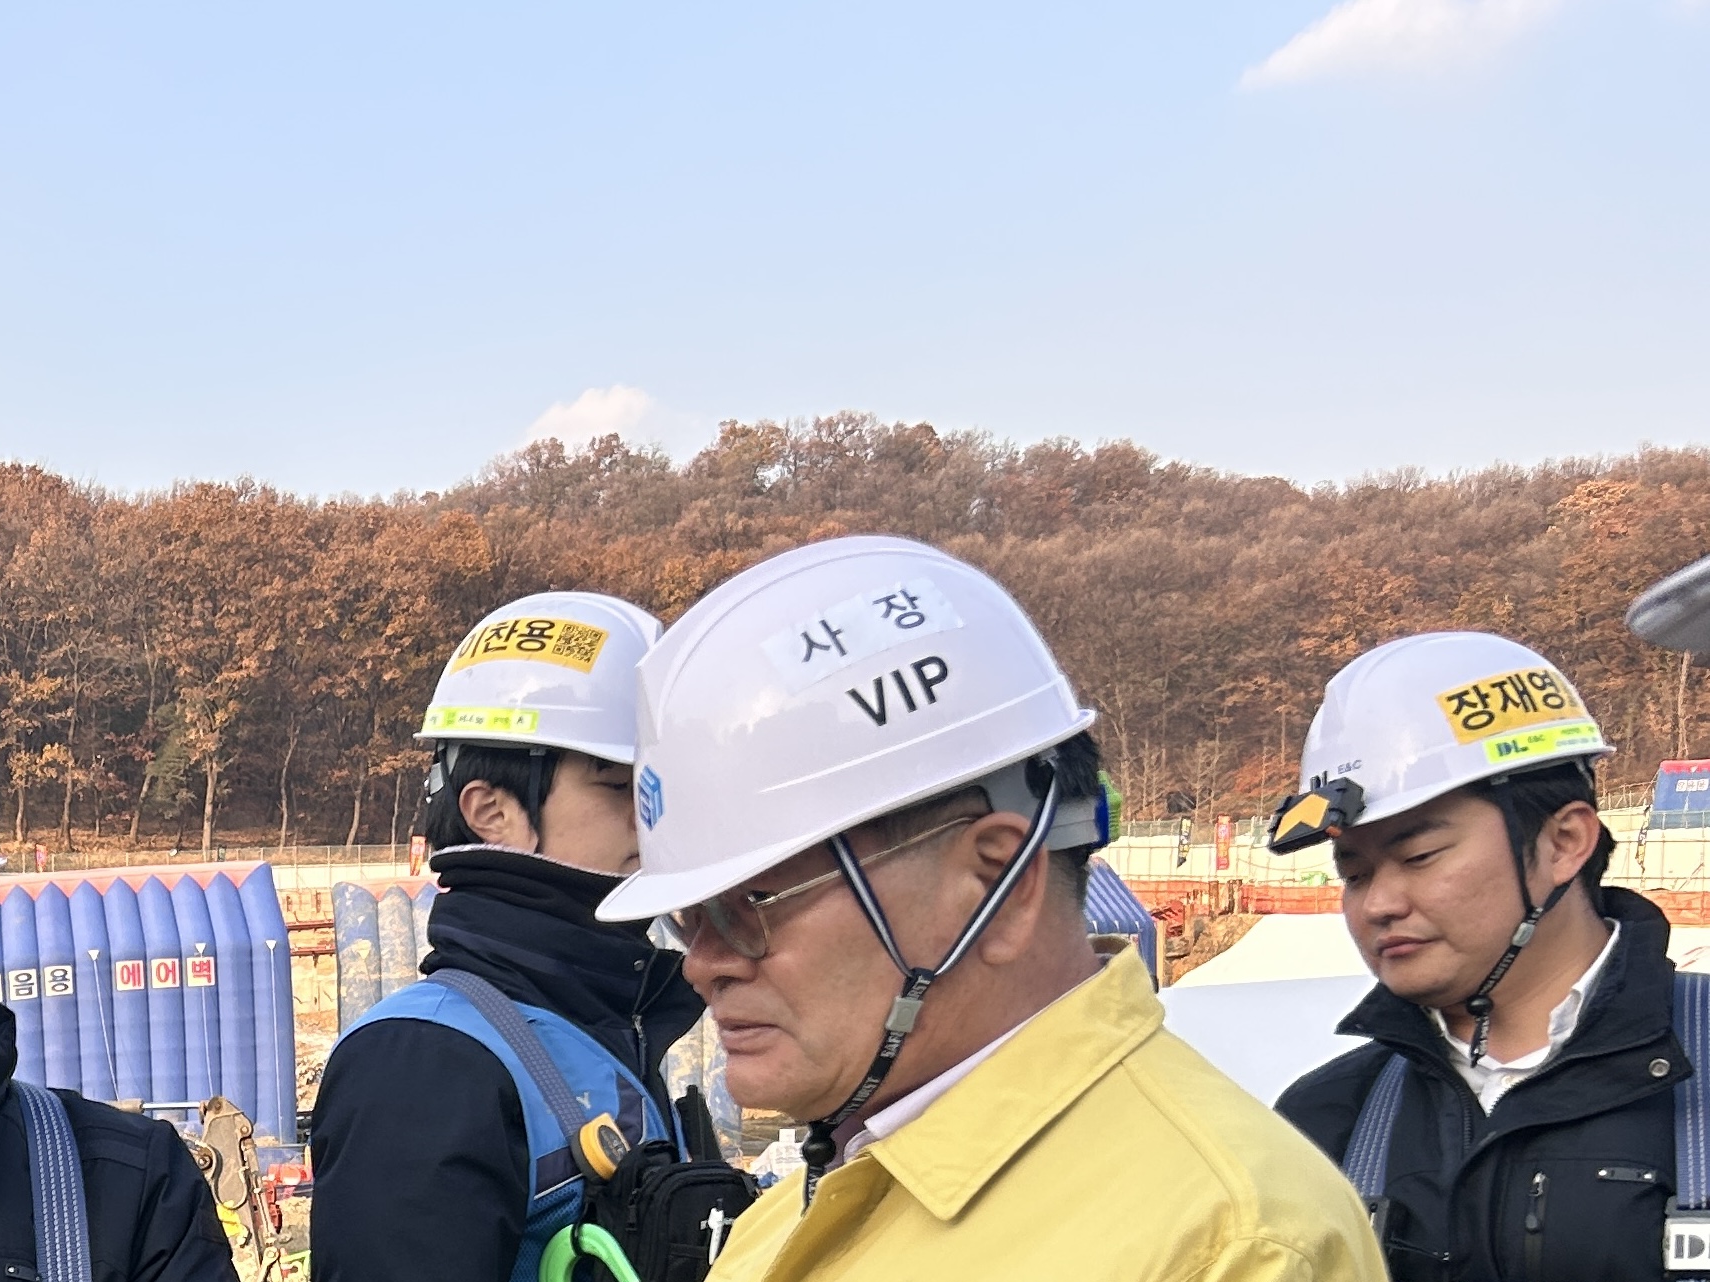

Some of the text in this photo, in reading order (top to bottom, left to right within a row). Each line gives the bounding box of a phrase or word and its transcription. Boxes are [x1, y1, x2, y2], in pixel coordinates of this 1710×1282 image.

[458, 619, 555, 659] 이찬용
[845, 656, 948, 726] VIP
[1446, 670, 1566, 731] 장재영
